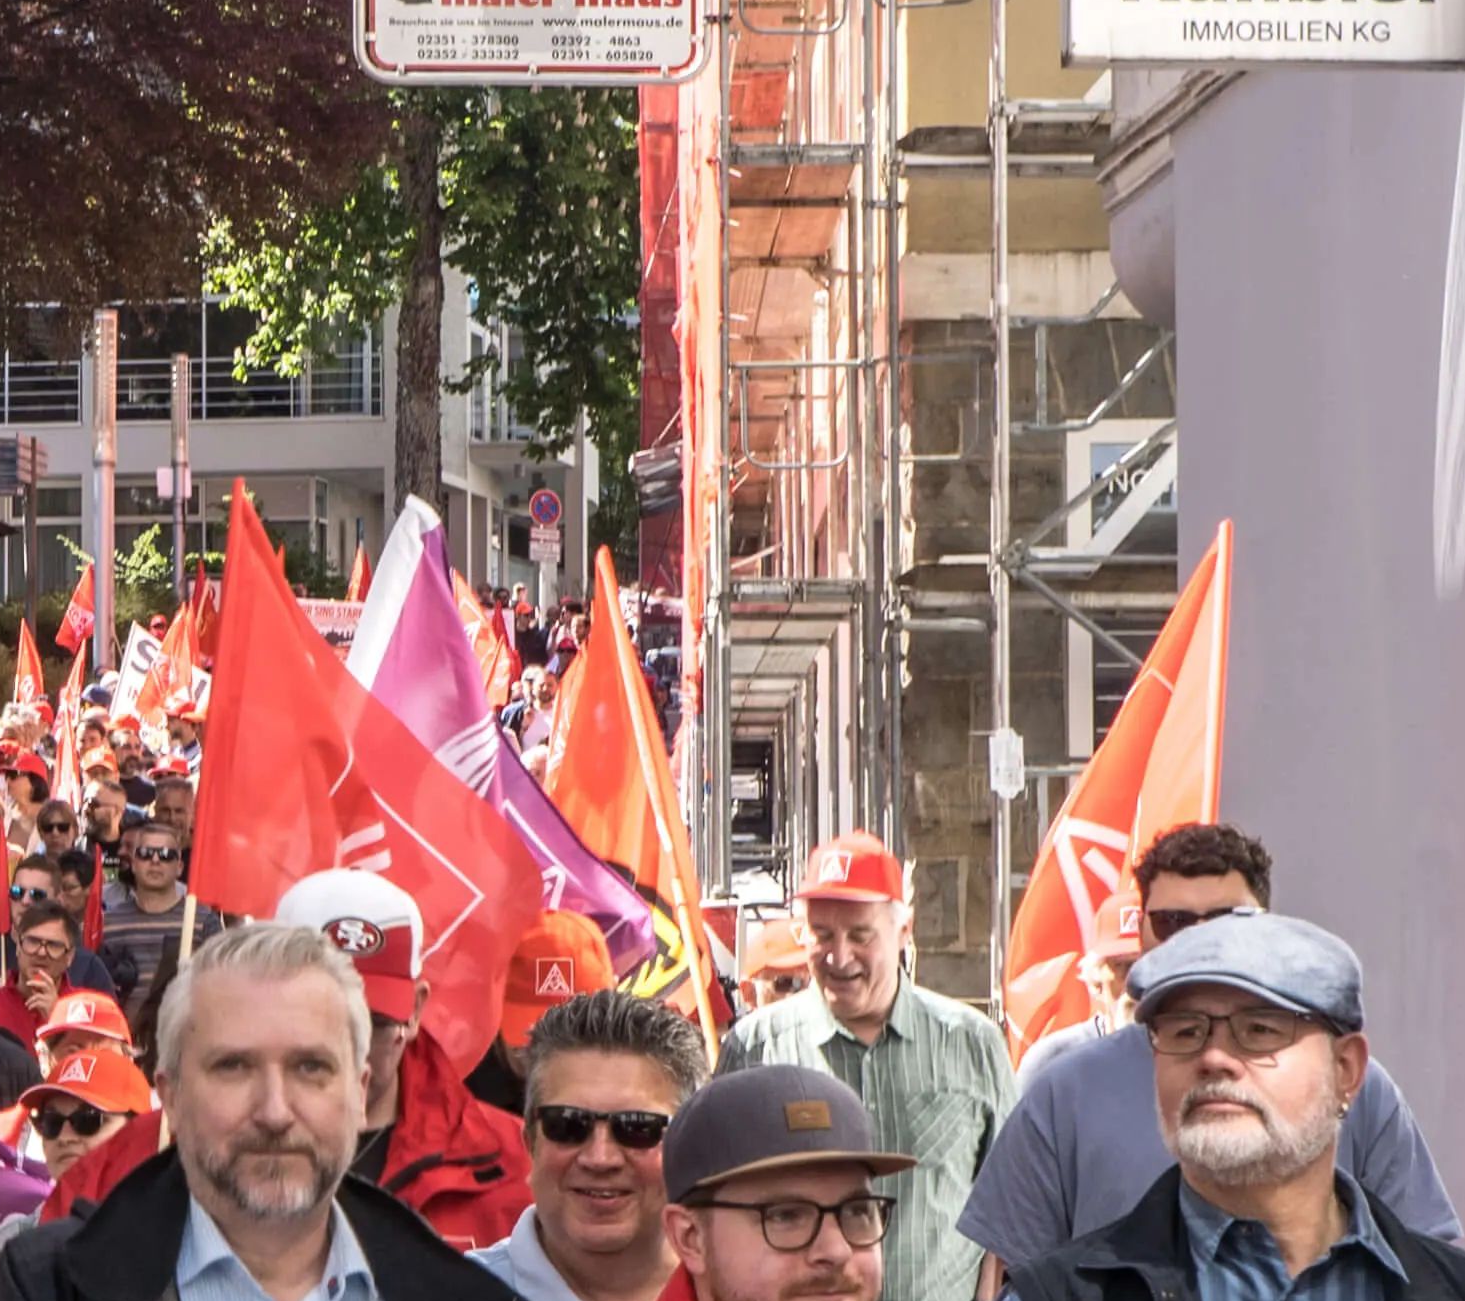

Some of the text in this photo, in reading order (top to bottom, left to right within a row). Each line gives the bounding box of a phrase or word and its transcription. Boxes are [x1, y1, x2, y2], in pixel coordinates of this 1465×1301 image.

[542, 16, 684, 28] www.malermaus.de
[1182, 20, 1391, 43] IMMOBILIEN KG
[417, 35, 456, 46] 02351
[552, 35, 592, 46] 02392
[609, 36, 642, 46] 4863
[417, 50, 458, 60] 02352
[552, 50, 590, 61] 02391
[605, 51, 654, 61] 605820
